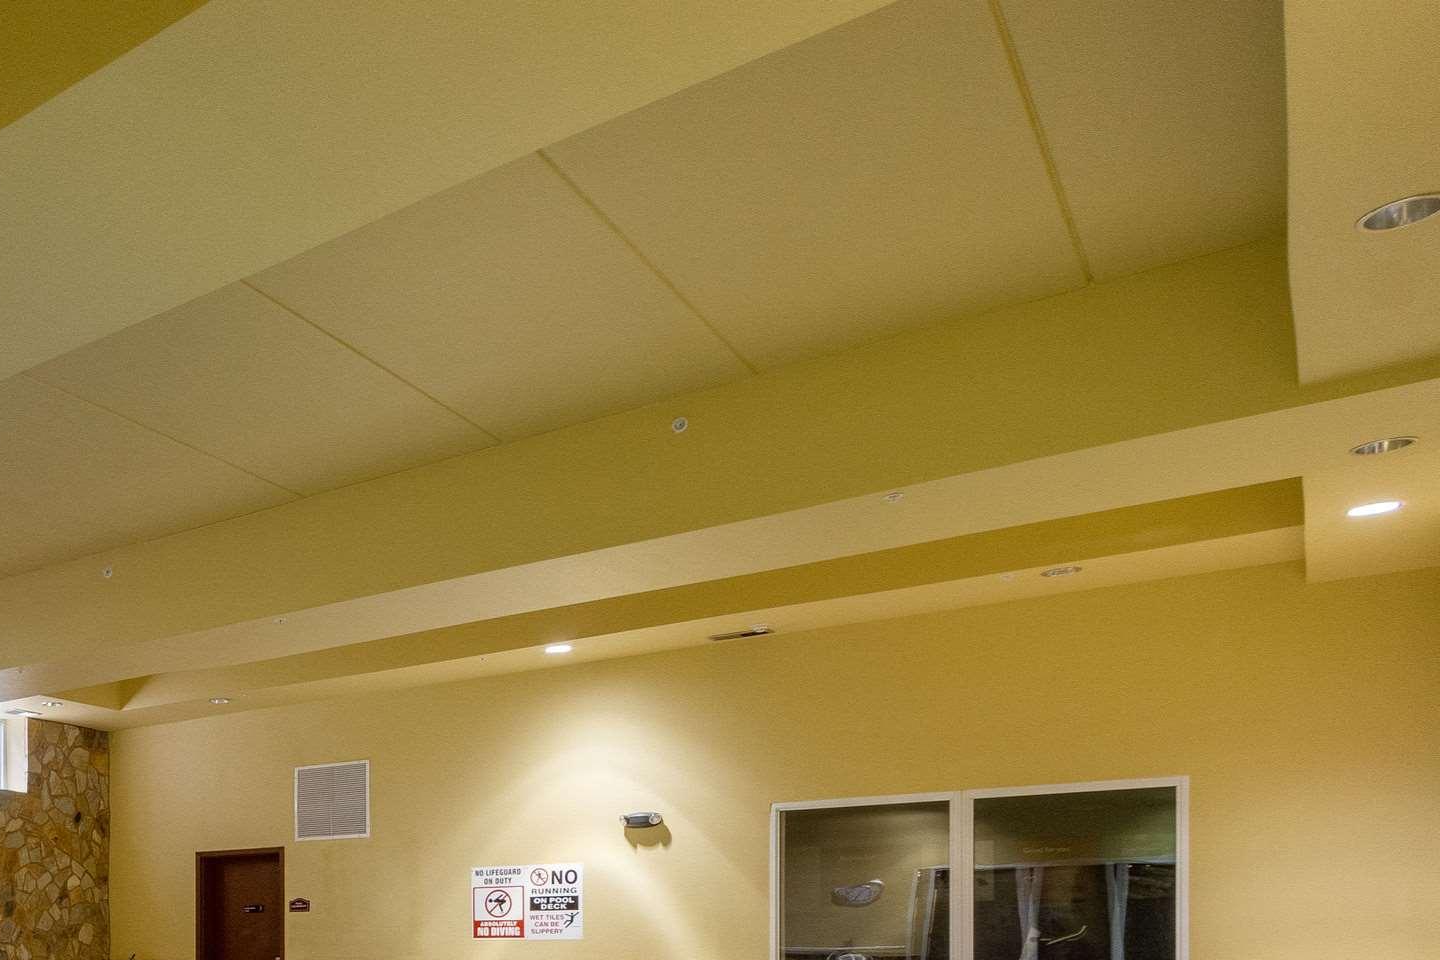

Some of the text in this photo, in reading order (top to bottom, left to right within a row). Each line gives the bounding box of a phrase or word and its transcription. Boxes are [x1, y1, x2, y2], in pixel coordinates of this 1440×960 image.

[486, 868, 521, 876] LIFEGUARD
[551, 869, 578, 885] NO
[531, 887, 578, 895] RUNNING
[477, 926, 521, 937] NO DIVING
